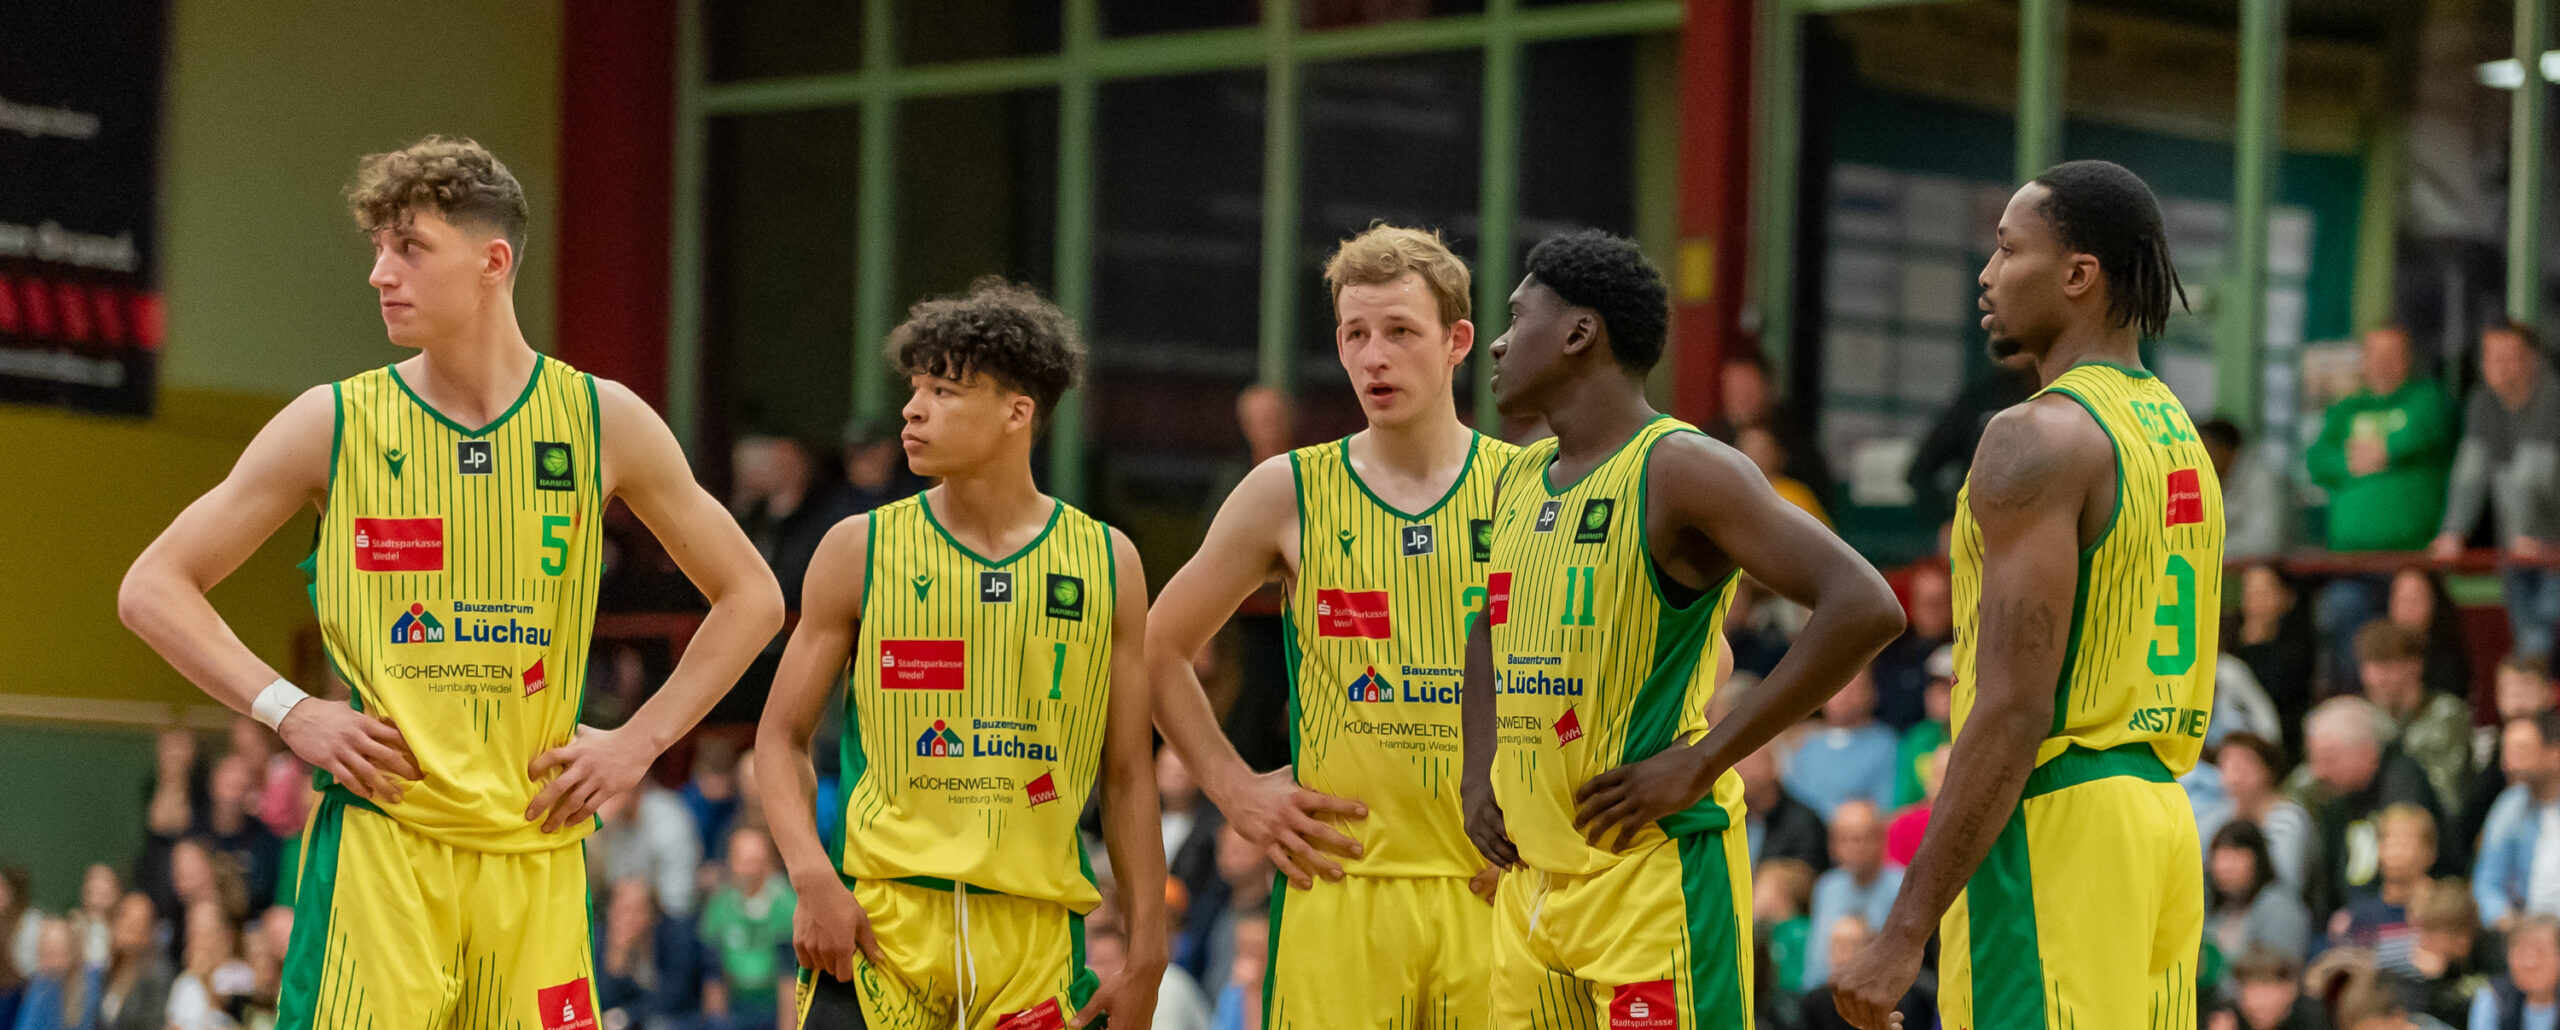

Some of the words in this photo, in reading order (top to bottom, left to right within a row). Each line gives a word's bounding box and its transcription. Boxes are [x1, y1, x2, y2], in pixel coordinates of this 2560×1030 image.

[372, 539, 442, 549] Stadtsparkasse
[541, 515, 570, 576] 5
[372, 551, 400, 560] Wedel
[1561, 567, 1595, 625] 11
[454, 601, 534, 614] Bauzentrum
[454, 617, 551, 646] Lüchau
[897, 659, 963, 669] Stadtsparkasse
[1507, 654, 1562, 665] Bauzentrum
[384, 664, 513, 679] KÜCHENWELTEN
[897, 671, 925, 679] Wedel
[1048, 643, 1066, 700] 1
[526, 678, 545, 694] KWH
[1507, 670, 1583, 696] Lüchau
[972, 719, 1037, 732] Bauzentrum
[1344, 720, 1458, 738] KÜCHENWELTEN
[1559, 726, 1581, 745] KWH
[972, 735, 1058, 762] Lüchau
[910, 775, 1014, 791] KÜCHENWELTEN
[1030, 790, 1056, 804] KWH
[1612, 1018, 1673, 1028] Stadtsparkasse
